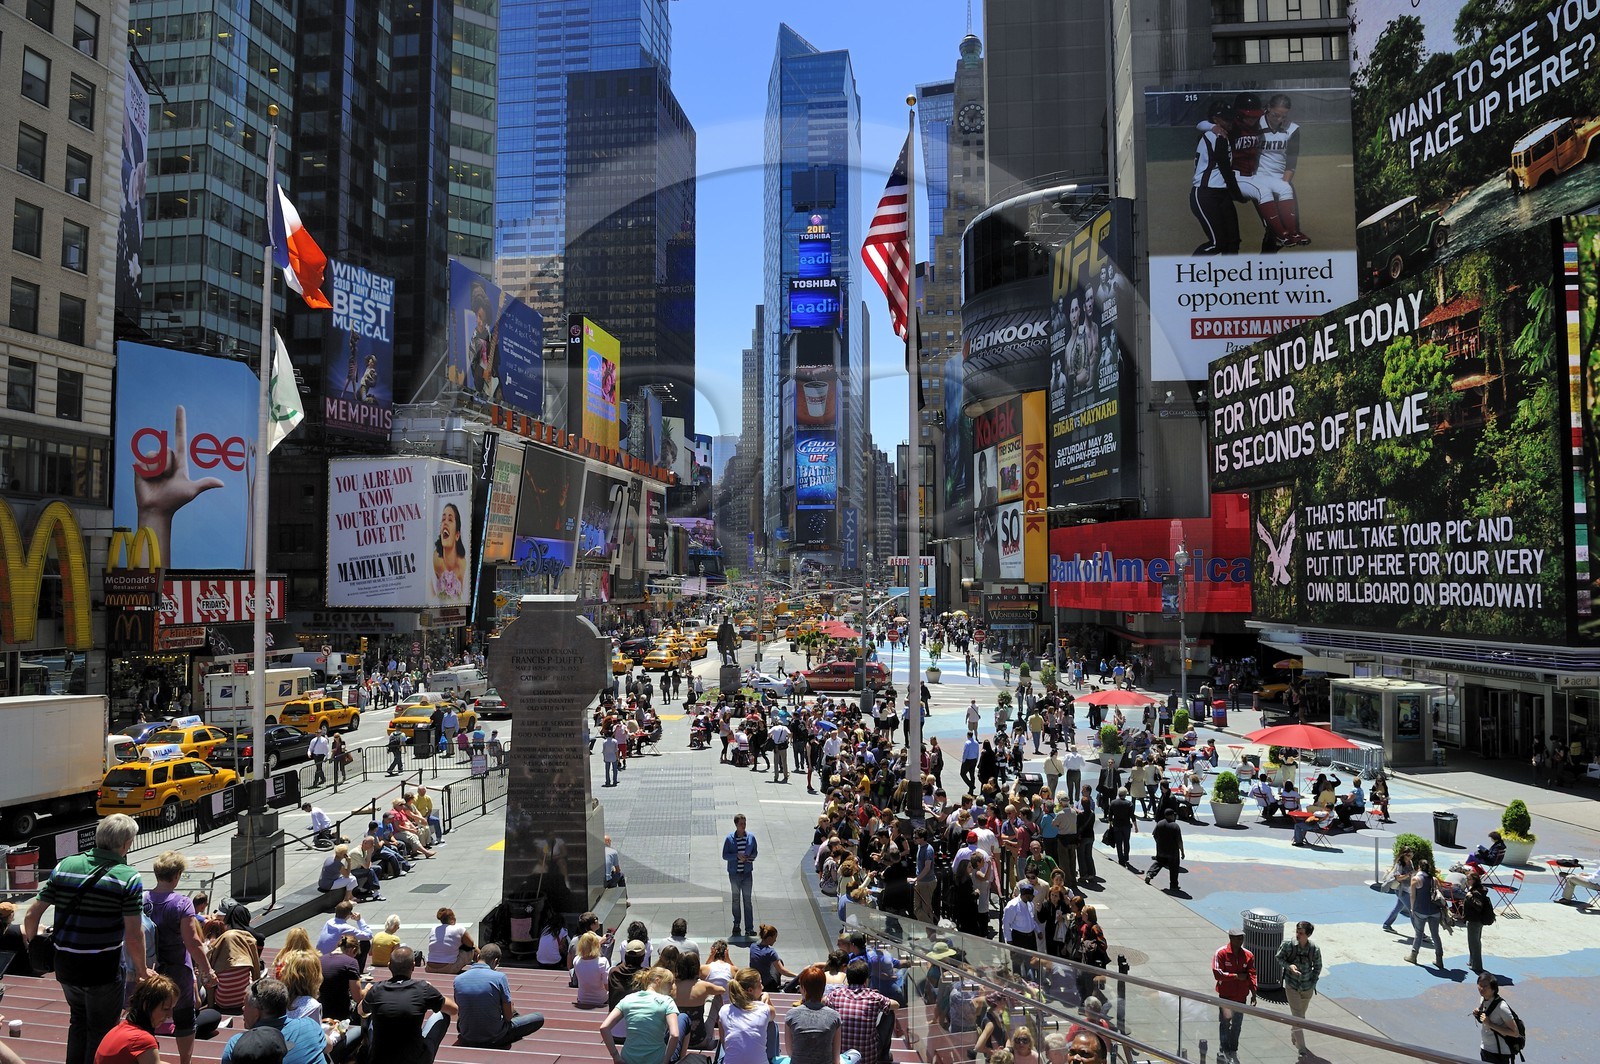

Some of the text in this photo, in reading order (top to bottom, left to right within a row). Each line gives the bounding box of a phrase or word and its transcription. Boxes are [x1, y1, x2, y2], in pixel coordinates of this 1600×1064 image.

[1389, 82, 1446, 142] WANT
[1453, 59, 1484, 101] TO
[1490, 21, 1540, 80] SEE
[1409, 33, 1596, 169] FACE UP HERE?
[807, 225, 825, 234] 2011
[1052, 209, 1112, 302] UFC
[331, 259, 393, 295] WINNER!
[793, 280, 837, 288] TOSHIBA
[1176, 258, 1334, 289] Helped injured
[333, 277, 392, 305] 2010 TONY AWARD
[1177, 284, 1332, 313] opponent win.
[333, 288, 391, 327] BEST
[332, 313, 390, 342] MUSICAL
[1195, 319, 1311, 336] SPORTSMANSH
[977, 346, 1003, 359] driving
[1003, 338, 1048, 351] emotion
[1213, 289, 1424, 399] COME INTO AE TODAY
[326, 397, 392, 429] MEMPHIS
[1053, 416, 1074, 437] EDGAR
[1080, 400, 1117, 427] MAYNARD
[1214, 385, 1295, 438] FOR YOUR
[975, 404, 1016, 449] Kodak
[1215, 392, 1429, 474] 15 SECONDS OF FAME
[809, 454, 829, 462] UFC
[1054, 457, 1066, 469] LIVE
[1067, 454, 1076, 465] ON
[1075, 441, 1117, 463] PAY-PER-VIEW
[1057, 432, 1113, 459] SATURDAY MAY 28
[335, 466, 414, 493] YOU ALREADY
[432, 473, 468, 494] MAMMA MIA!
[799, 465, 836, 477] BATTLE
[809, 475, 835, 487] BAYOU
[358, 488, 394, 509] KNOW
[1025, 443, 1045, 534] Kodak
[335, 503, 421, 531] YOU'RE GONNA
[1001, 508, 1020, 545] SO
[1305, 502, 1345, 526] THATS
[356, 523, 405, 547] LOVE IT!
[846, 510, 855, 567] TRYX
[1306, 516, 1514, 551] WE WILL TAKE YOUR PIC AND
[337, 558, 386, 583] MAMMA
[387, 552, 416, 576] MIA!
[520, 538, 565, 589] Disney
[890, 557, 934, 566] AÉROPTALE
[1306, 548, 1545, 576] PUT IT UP HERE FOR YOUR VERY
[105, 576, 156, 584] McDonald's
[1306, 582, 1543, 609] OWN BILLBOARD ON BROADWAY!
[313, 613, 382, 622] DIGITAL
[989, 610, 1038, 620] WONDERLAND
[511, 656, 546, 664] FRANCIS
[556, 656, 584, 664] DUFFY
[1430, 660, 1537, 681] AMERICAN EAGLE OUTFITTERS
[1570, 676, 1592, 686] aerie
[152, 748, 173, 758] MILAN
